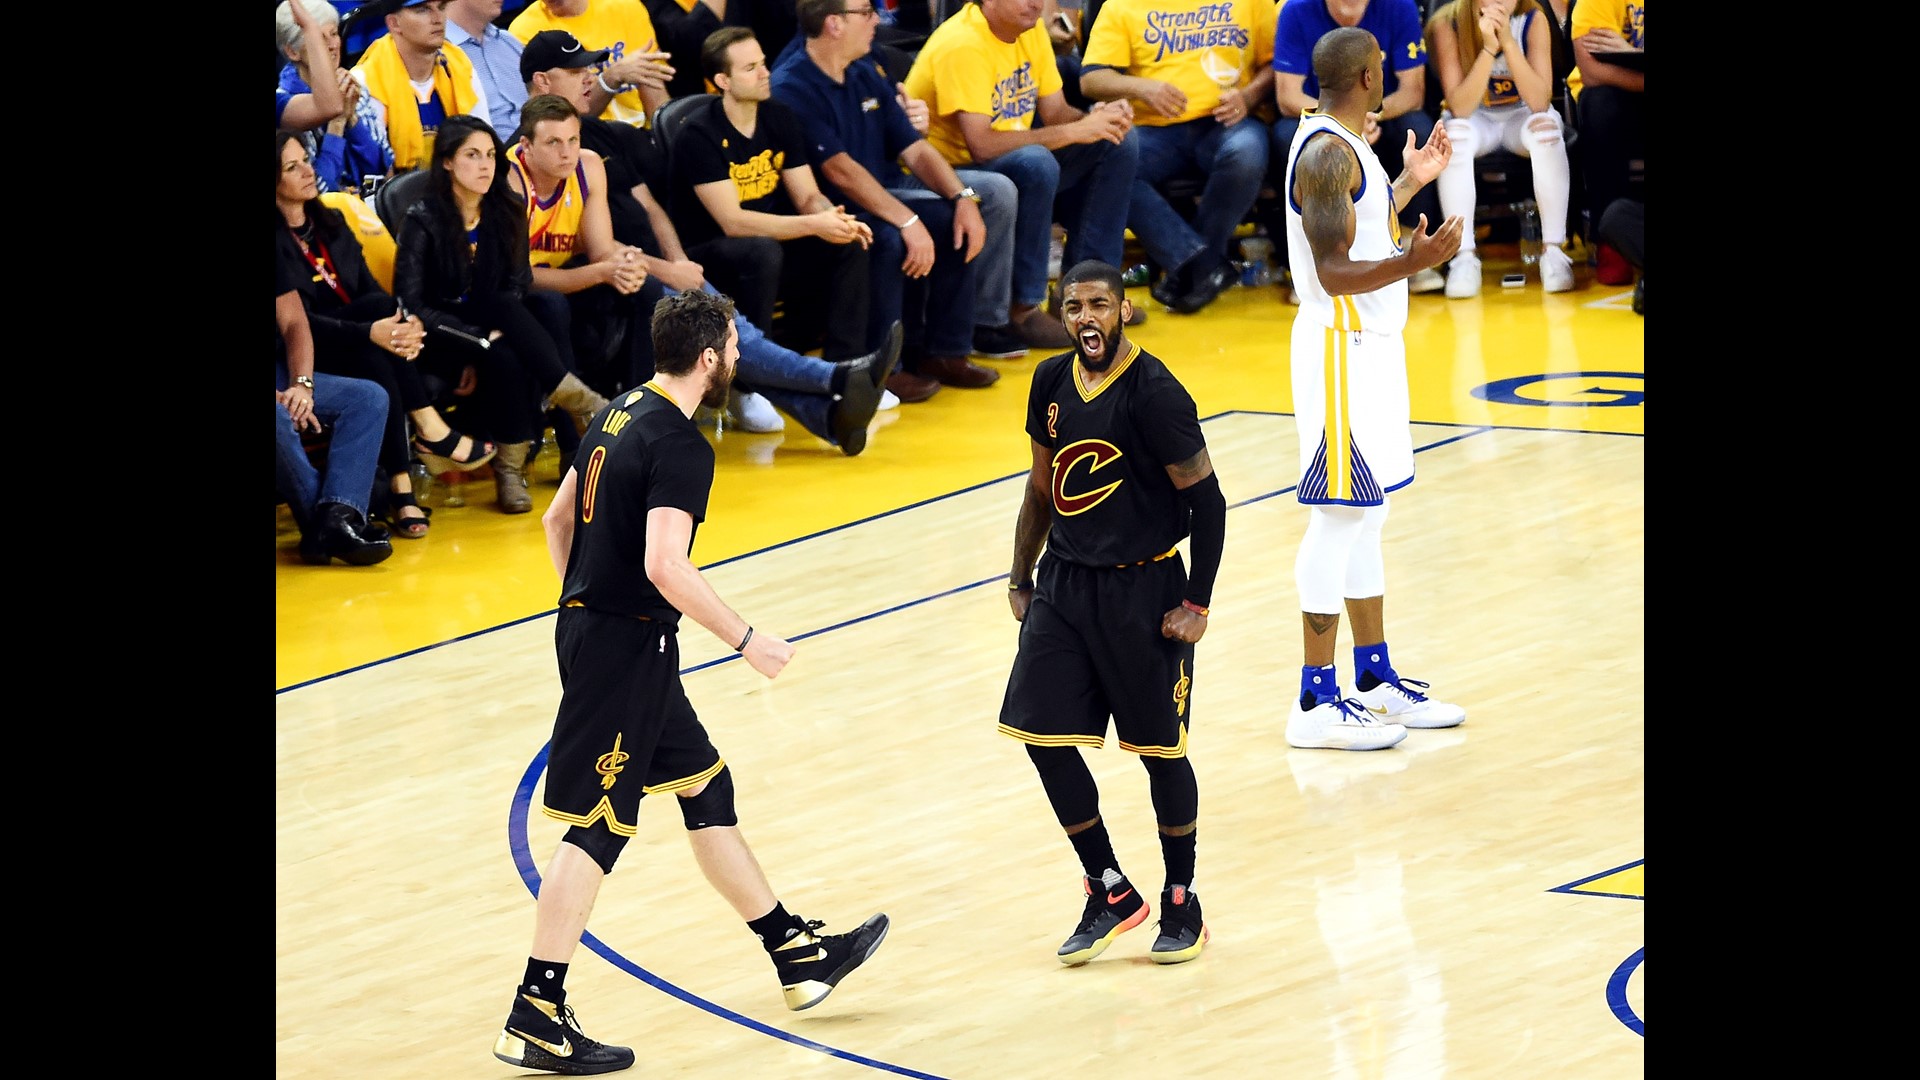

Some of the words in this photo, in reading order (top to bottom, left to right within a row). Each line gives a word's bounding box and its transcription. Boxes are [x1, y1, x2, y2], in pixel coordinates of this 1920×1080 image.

[1144, 2, 1232, 44] Strength
[1494, 80, 1512, 95] 30
[601, 408, 632, 436] LOVE
[1047, 402, 1059, 438] 2
[583, 445, 607, 524] 0
[1052, 439, 1123, 517] C
